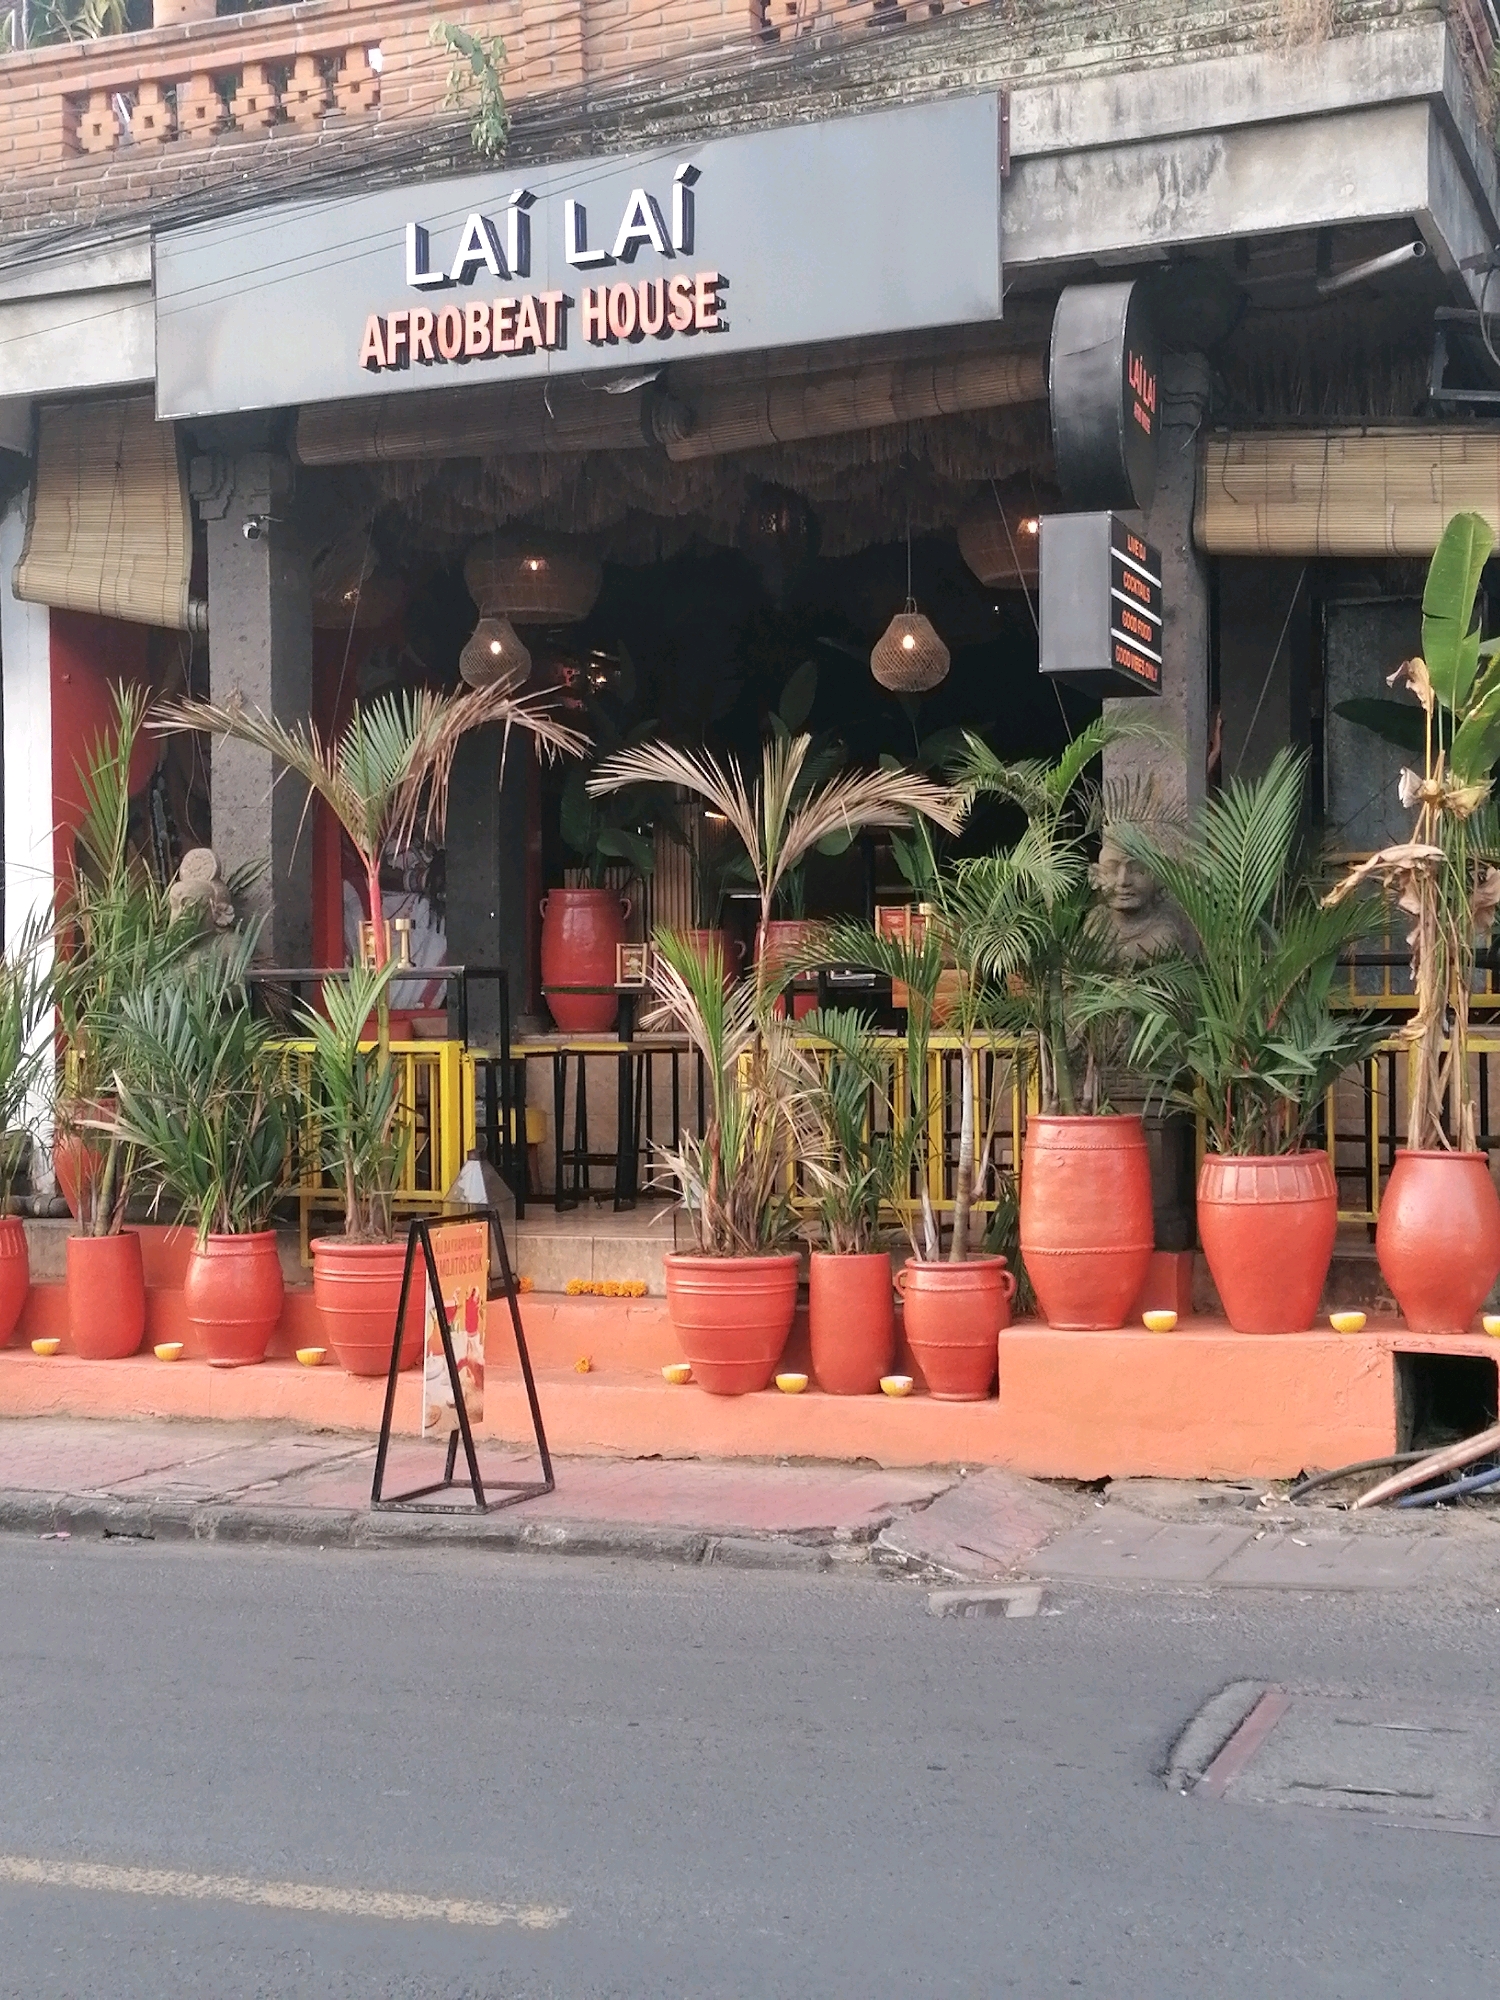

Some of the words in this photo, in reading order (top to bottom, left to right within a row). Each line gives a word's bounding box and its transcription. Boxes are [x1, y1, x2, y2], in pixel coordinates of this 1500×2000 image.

[405, 188, 533, 289] LAÍ
[564, 163, 698, 267] LAÍ
[359, 290, 568, 371] AFROBEAT
[581, 271, 724, 344] HOUSE
[1127, 534, 1140, 558] LIVE
[1123, 570, 1151, 604] COCKTAILS
[1122, 609, 1138, 634] GOOD
[1137, 618, 1153, 642] FOOD
[1115, 644, 1131, 668] GOOD
[1131, 653, 1145, 676] VIBES
